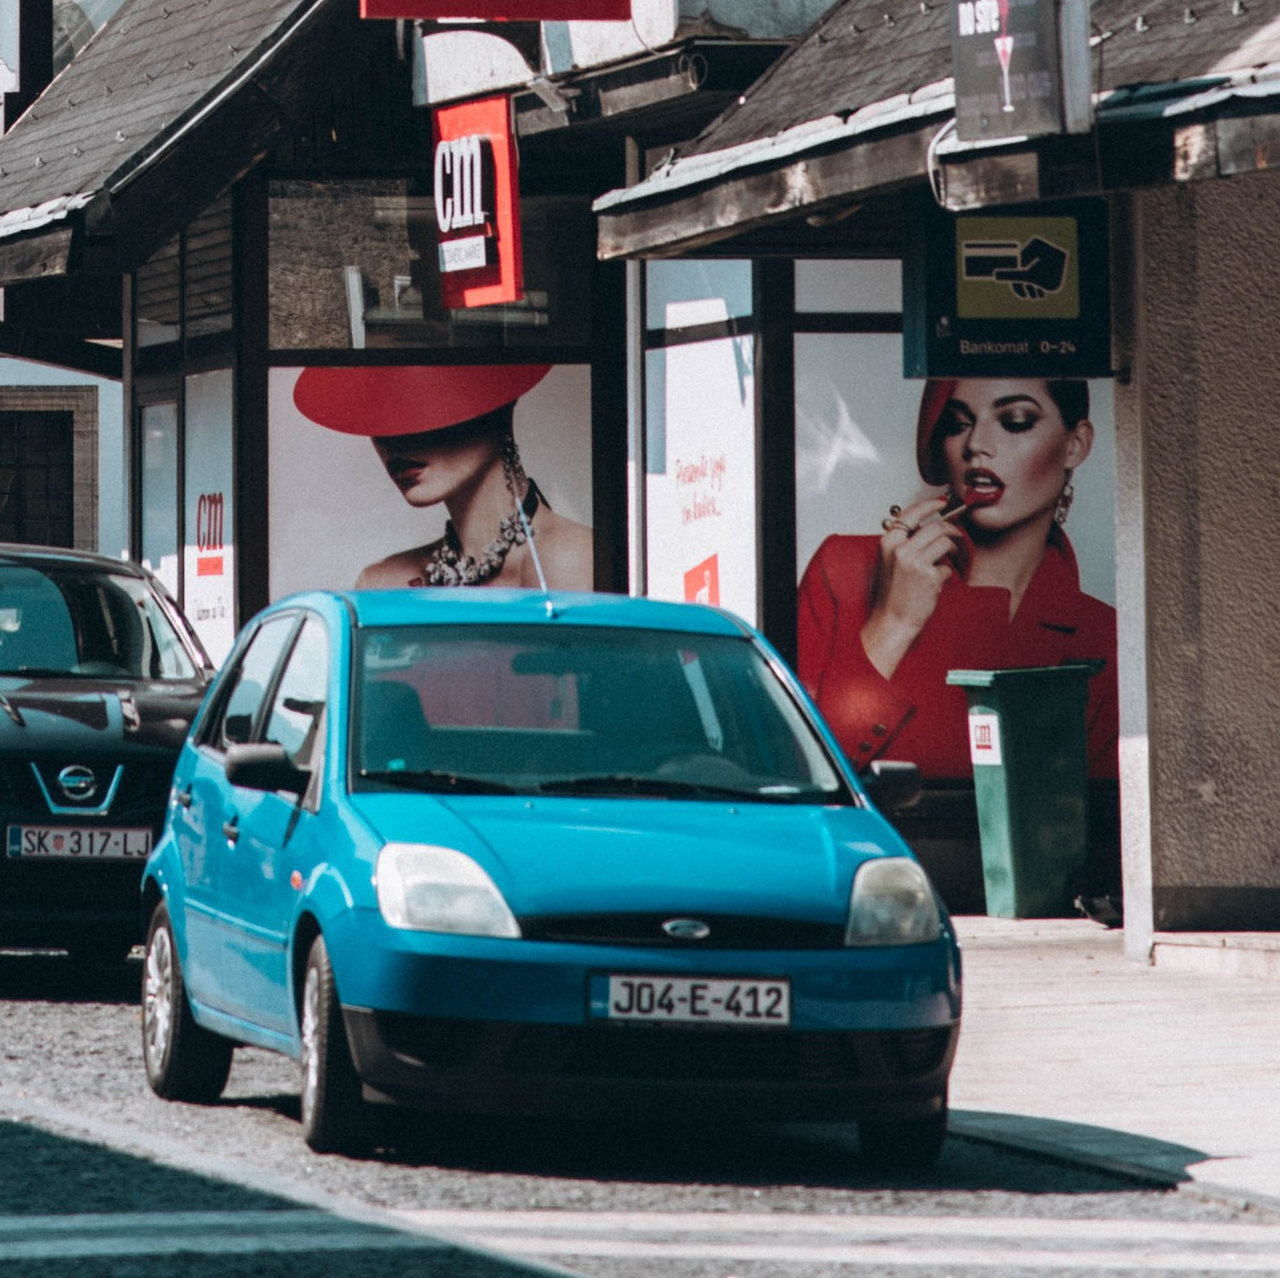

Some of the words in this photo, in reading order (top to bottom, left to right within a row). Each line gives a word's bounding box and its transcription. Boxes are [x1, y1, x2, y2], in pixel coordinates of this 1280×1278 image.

[434, 134, 484, 233] cm
[960, 339, 1029, 354] Bankomat
[1040, 340, 1076, 355] 0-24
[197, 492, 224, 552] cm
[24, 830, 50, 853] SK
[614, 981, 783, 1019] J04-E-412
